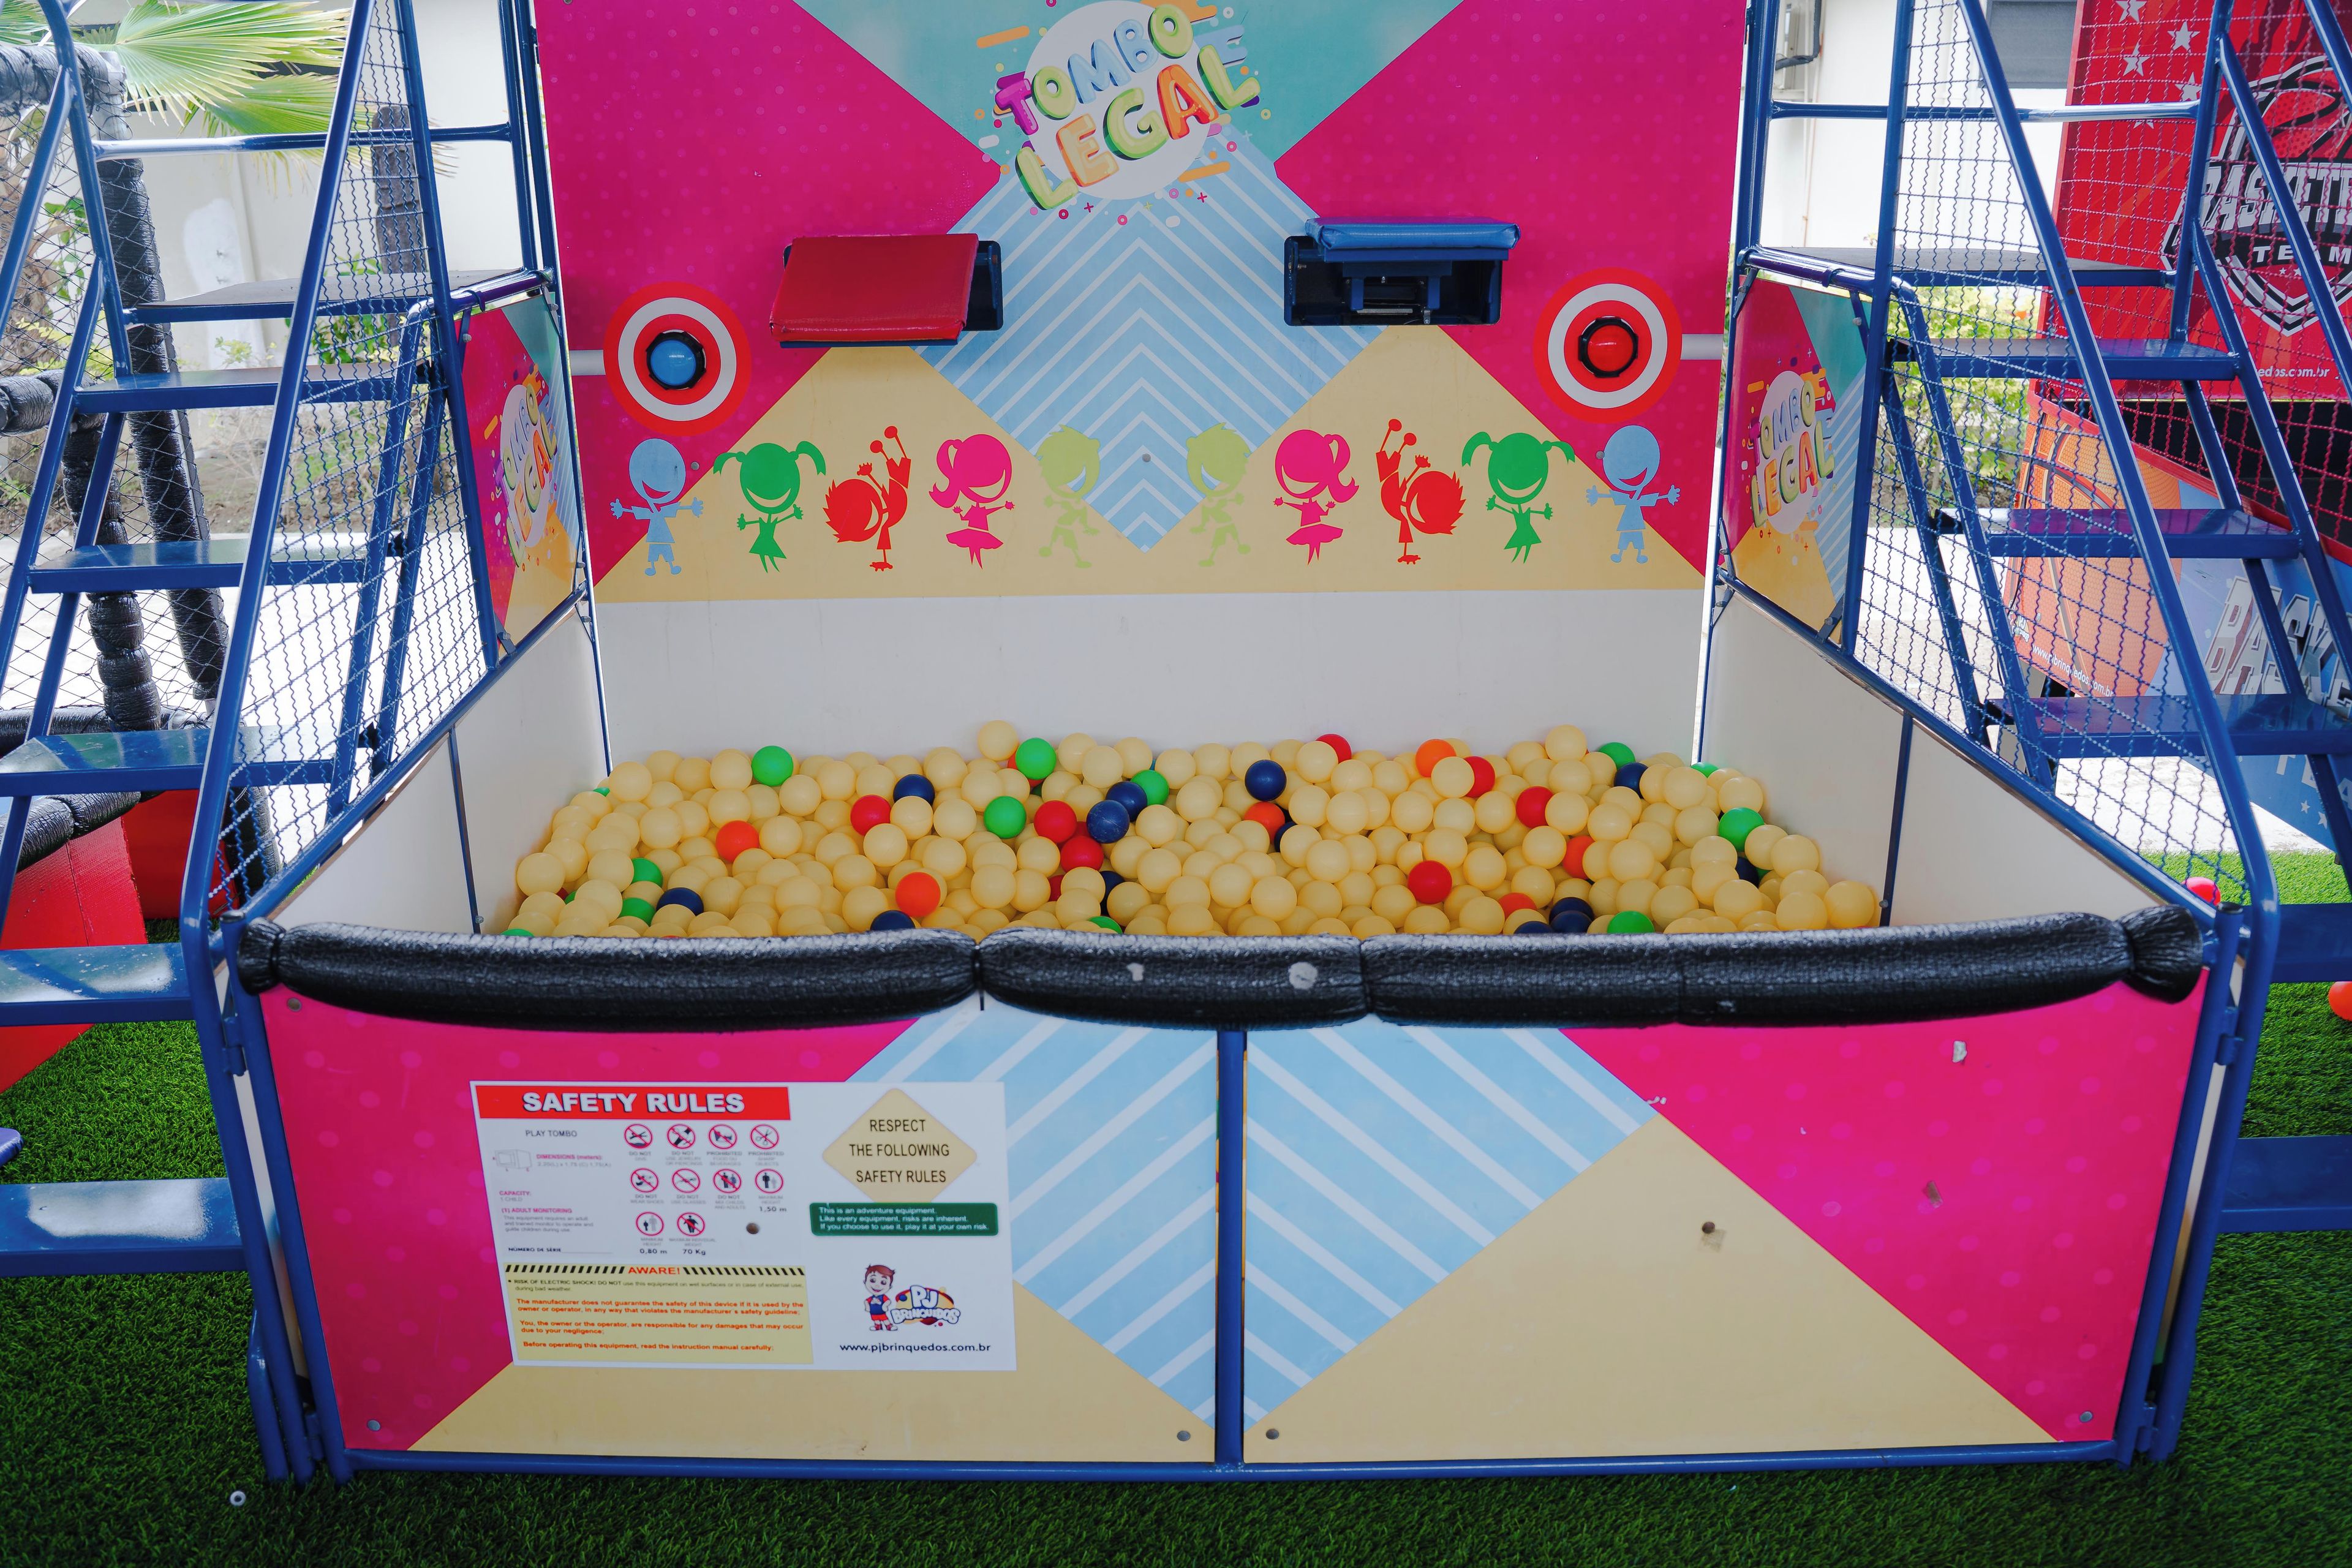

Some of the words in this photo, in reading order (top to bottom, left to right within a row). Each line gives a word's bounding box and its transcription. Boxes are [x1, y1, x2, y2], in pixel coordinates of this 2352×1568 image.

[995, 4, 1194, 135] TOMBO
[1016, 44, 1261, 210] LEGAL
[2200, 162, 2352, 235] BASKET
[2253, 245, 2351, 264] TEM
[1749, 380, 1815, 466] TOMBO
[495, 383, 538, 507] TOMBO
[1751, 421, 1835, 528] LEGAL
[506, 412, 557, 568] LEGAL
[523, 1093, 637, 1112] SAFETY
[647, 1093, 745, 1113] RULES
[869, 1118, 927, 1132] RESPECT
[849, 1144, 873, 1156] THE
[876, 1144, 950, 1156] FOLLOWING
[856, 1170, 902, 1183] SAFETY
[907, 1170, 946, 1183] RULES
[895, 1207, 937, 1216] equipment.
[910, 1285, 939, 1308] PJ
[840, 1343, 990, 1352] www.pjbrinquedos.com.br
